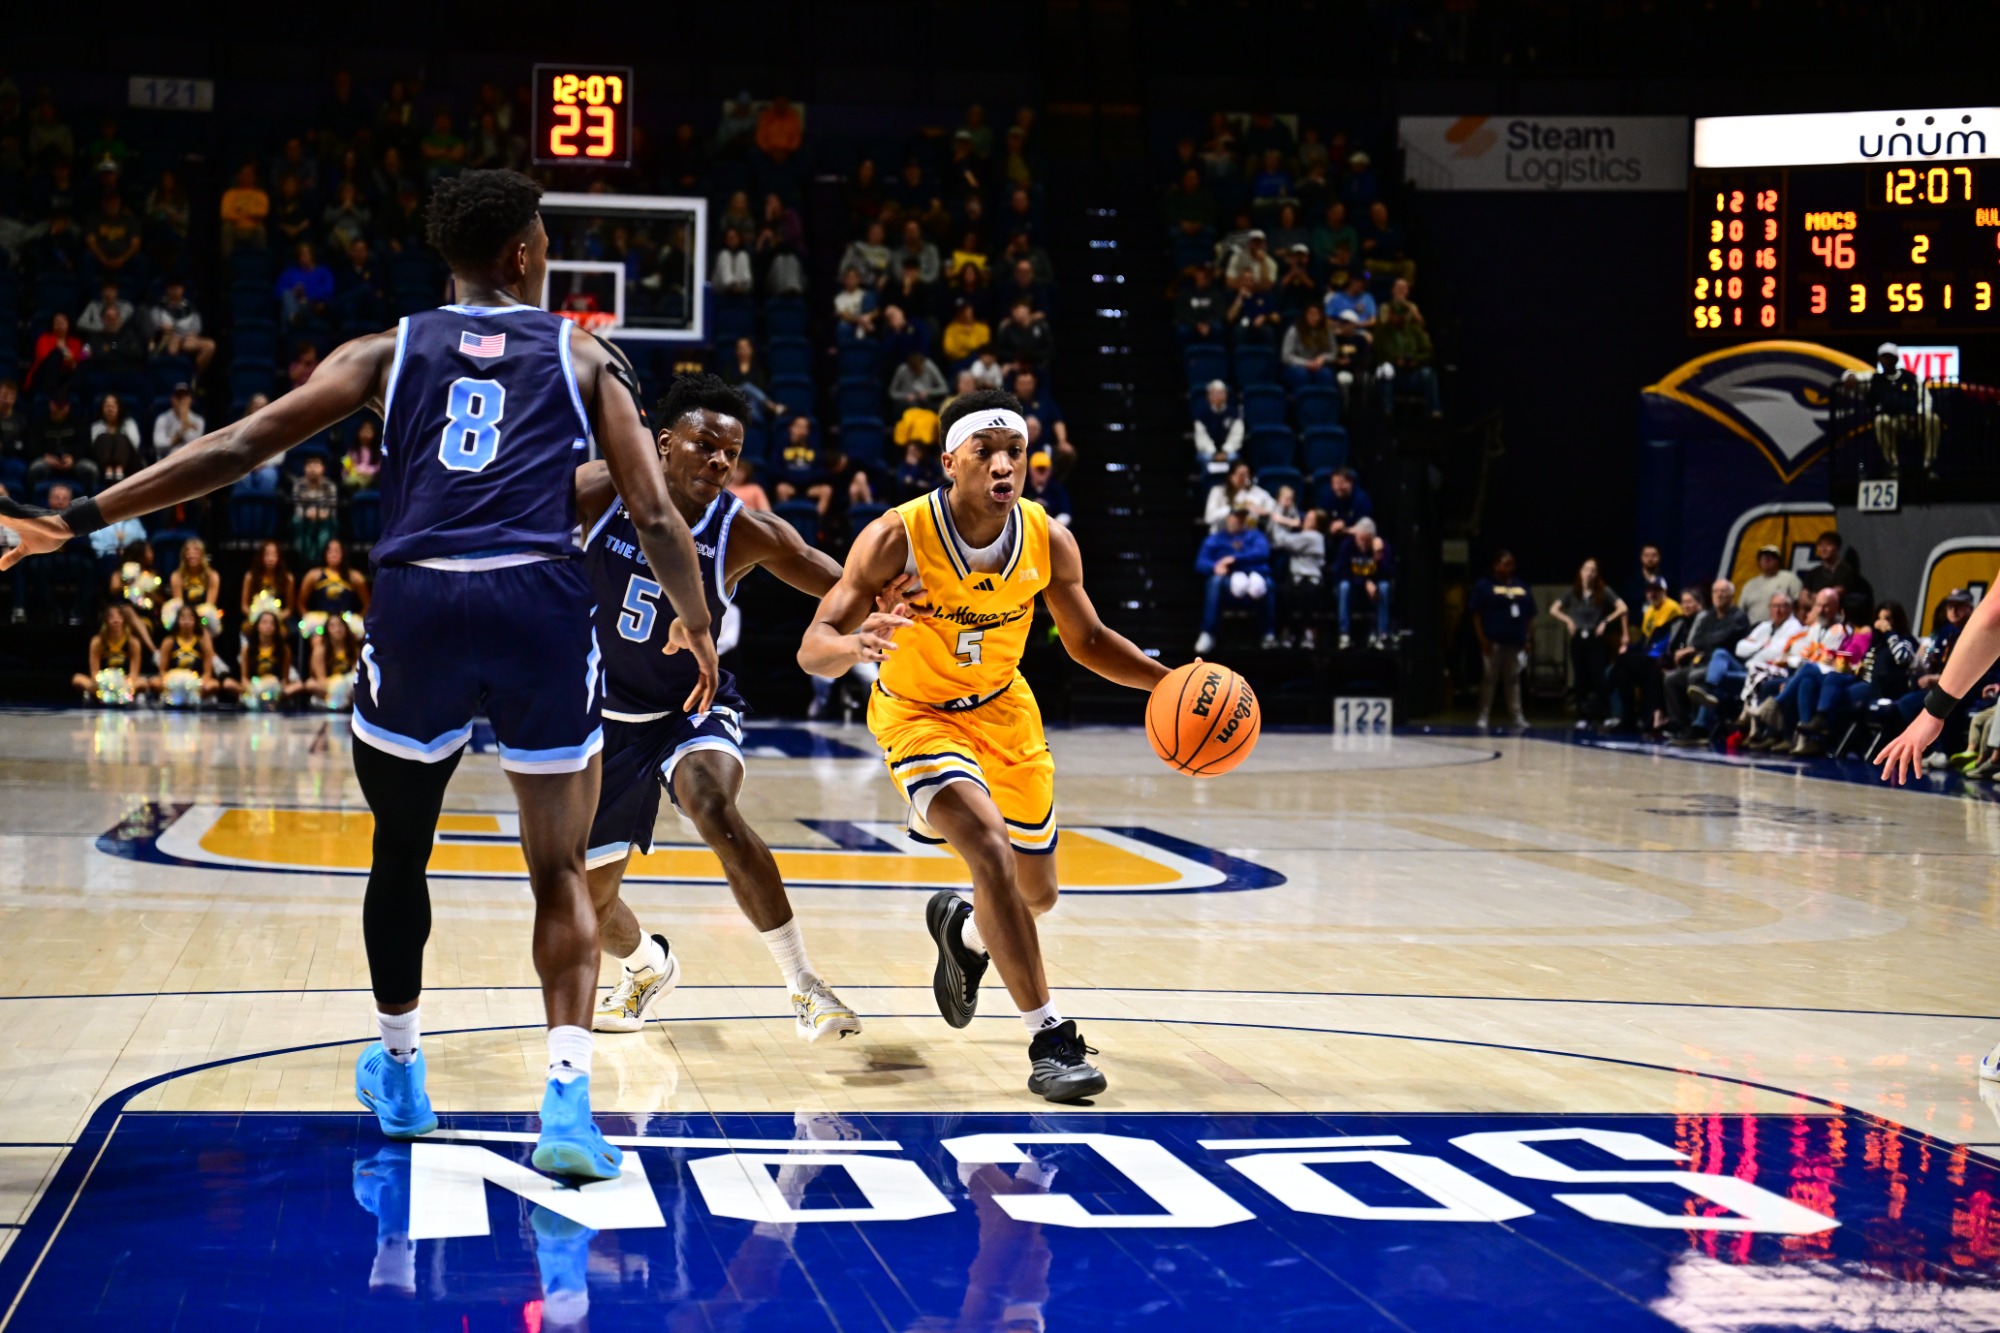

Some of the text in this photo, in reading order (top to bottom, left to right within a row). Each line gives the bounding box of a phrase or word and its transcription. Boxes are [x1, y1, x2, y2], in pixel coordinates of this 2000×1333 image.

[145, 81, 196, 105] 121
[553, 74, 622, 105] 12:07
[550, 104, 614, 157] 23
[1507, 121, 1614, 149] Steam
[1505, 153, 1642, 189] Logistics
[1885, 167, 1972, 205] 12:07
[1716, 190, 1778, 213] 1 2 12
[1711, 218, 1777, 242] 3 0 3
[1805, 212, 1857, 231] MOCS
[1708, 247, 1776, 271] 5 0 16
[1811, 233, 1856, 269] 46
[1911, 235, 1930, 264] 2
[1727, 277, 1743, 299] 0
[1762, 276, 1776, 299] 2
[1811, 282, 1991, 313] 3 3 55 1 3
[1734, 307, 1742, 326] 1
[1761, 305, 1776, 328] 0
[1903, 353, 1953, 384] XIT
[438, 377, 506, 472] 8
[1862, 484, 1895, 507] 125
[604, 535, 635, 559] THE
[616, 573, 662, 643] 5
[955, 630, 985, 668] 5
[1192, 671, 1222, 717] NCAA
[1216, 681, 1253, 744] Wilson
[1341, 702, 1386, 725] 122
